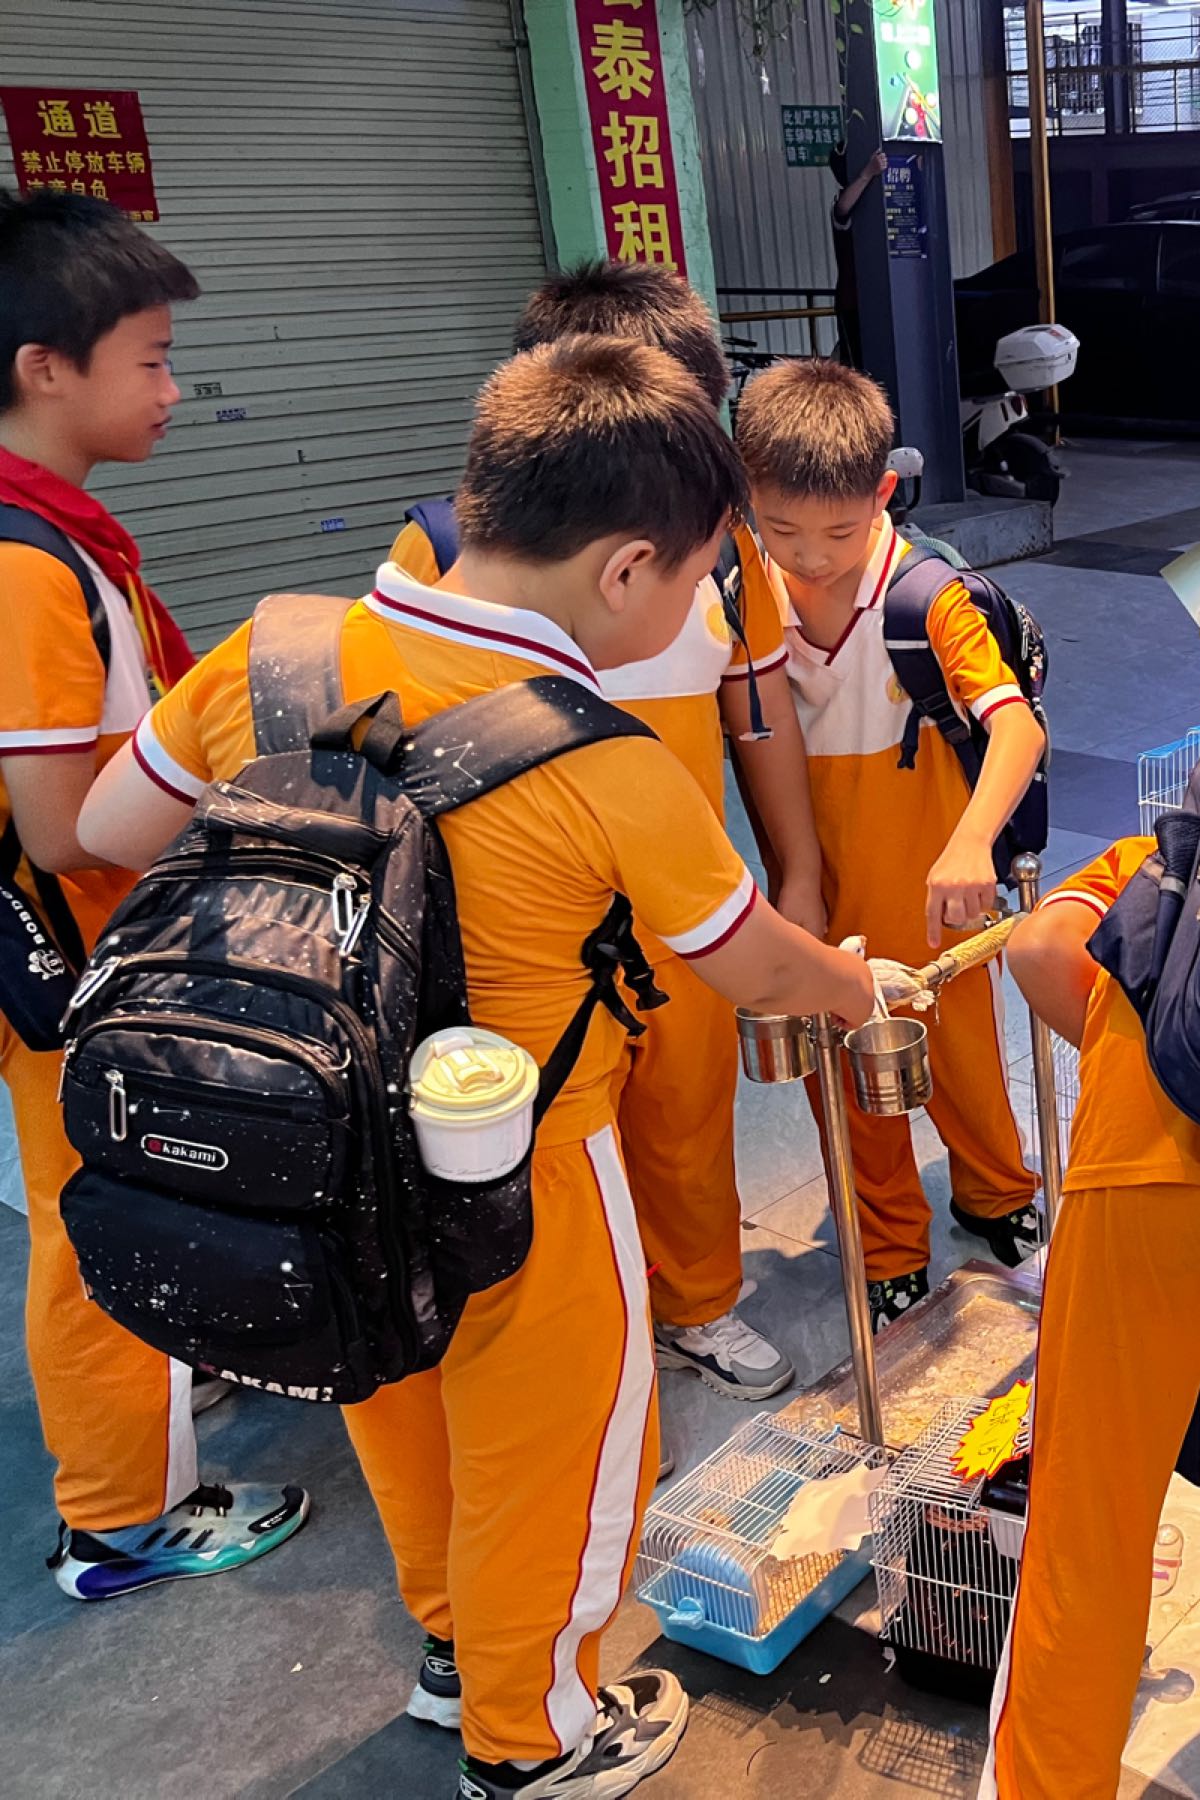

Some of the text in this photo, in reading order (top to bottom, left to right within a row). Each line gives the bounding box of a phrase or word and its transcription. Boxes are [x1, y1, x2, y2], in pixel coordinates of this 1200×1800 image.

[37, 99, 122, 138] 通道
[583, 0, 678, 272] 泰招租
[21, 149, 146, 174] 禁止停放车辆
[162, 1142, 216, 1163] kakami
